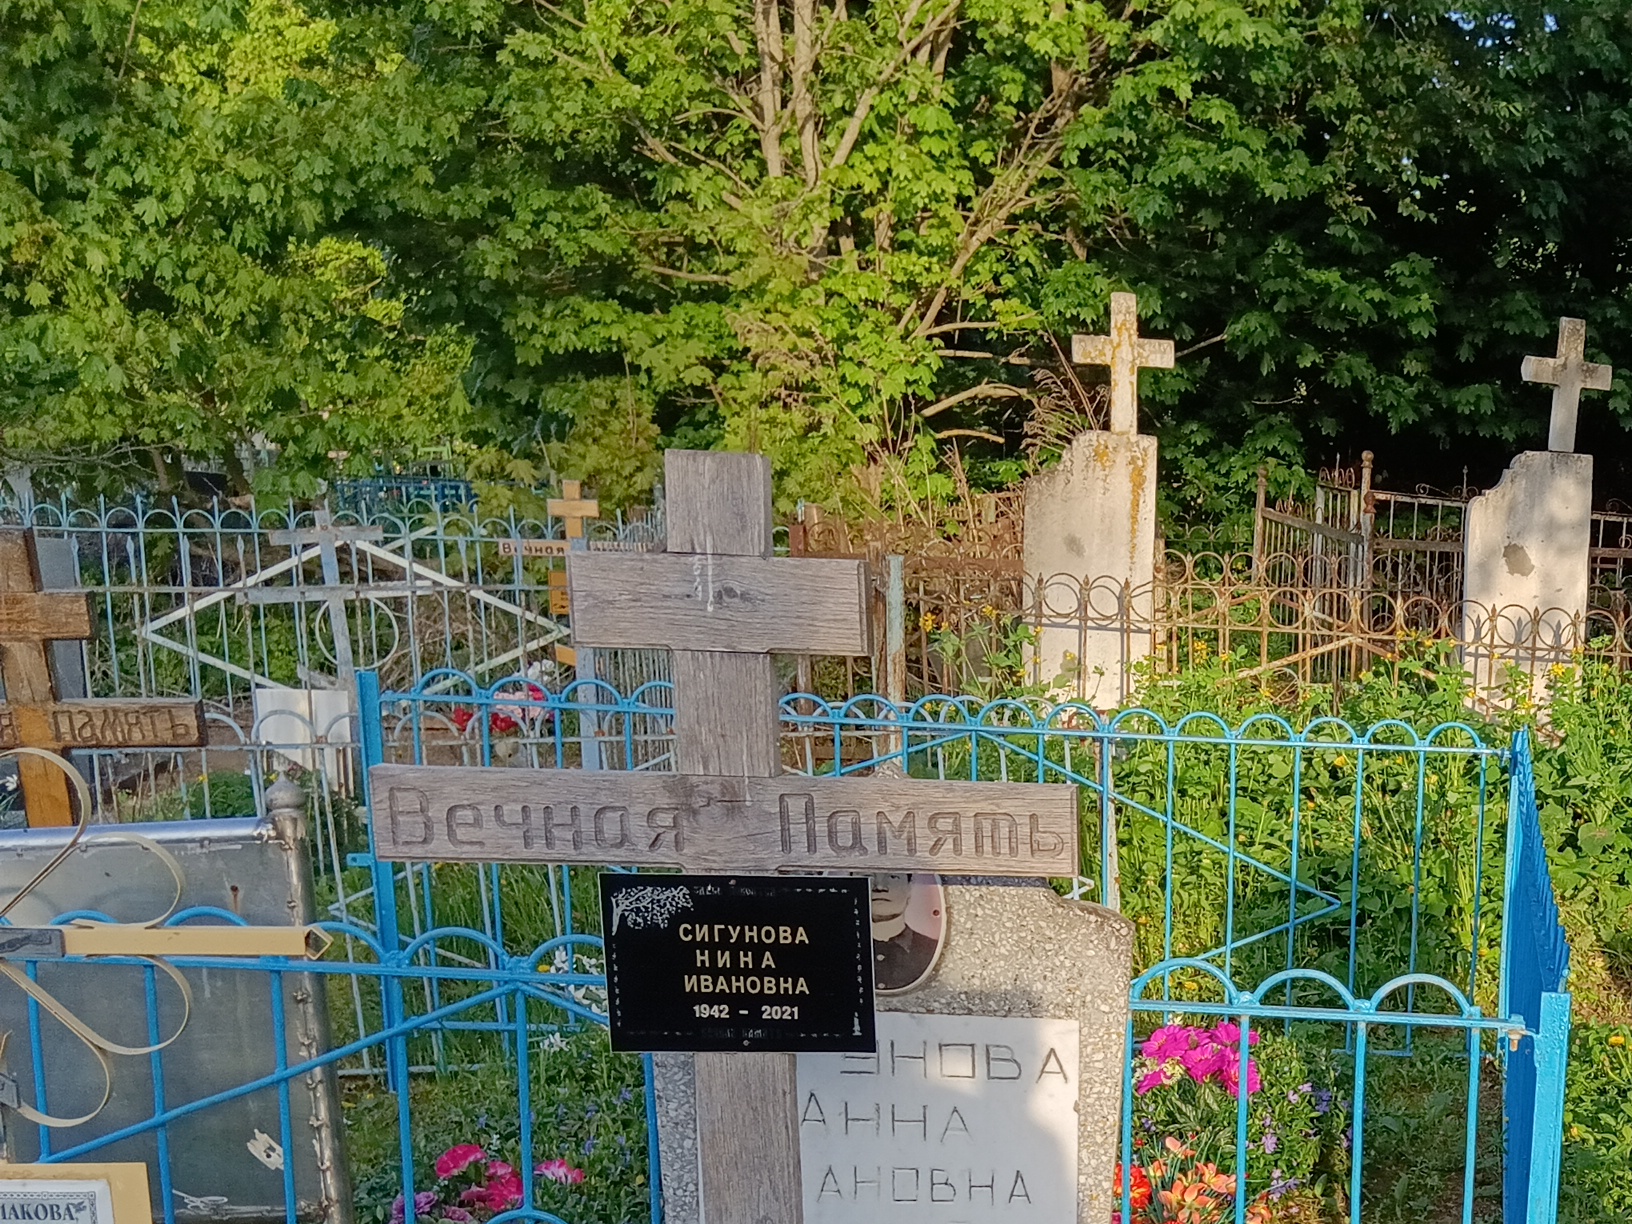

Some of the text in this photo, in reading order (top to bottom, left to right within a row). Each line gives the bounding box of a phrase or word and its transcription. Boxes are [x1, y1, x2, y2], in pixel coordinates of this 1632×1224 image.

[388, 786, 1065, 858] Вечная Память
[678, 923, 809, 945] СИГУНОВА
[696, 949, 776, 969] НИНА
[684, 975, 810, 995] ИВАНОВНА
[693, 1004, 730, 1019] 1942
[761, 1006, 799, 1020] 2021
[802, 1090, 972, 1144] АННА
[817, 1166, 1032, 1206] АНОВНА
